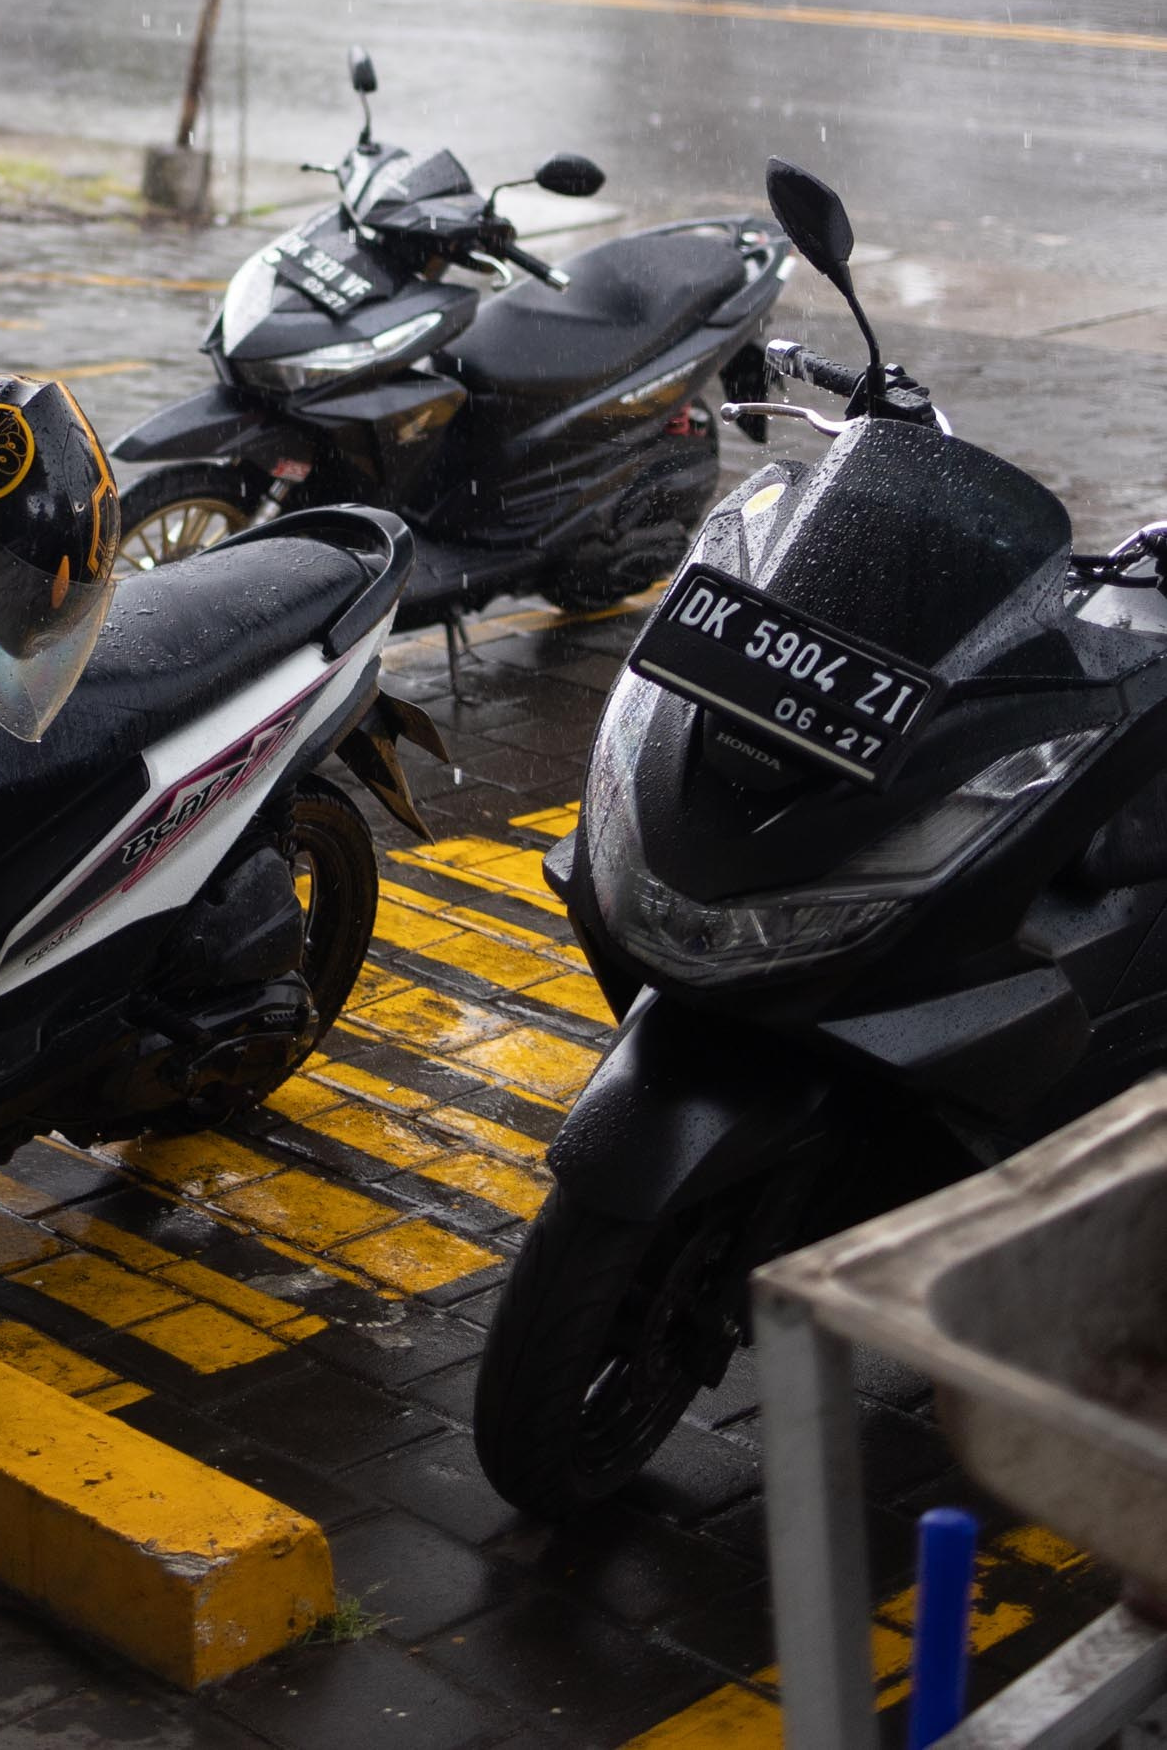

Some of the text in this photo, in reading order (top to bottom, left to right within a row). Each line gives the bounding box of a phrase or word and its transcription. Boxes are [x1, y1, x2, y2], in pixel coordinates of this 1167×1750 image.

[679, 588, 912, 725] DK 5904 ZI
[715, 732, 781, 771] HONDA
